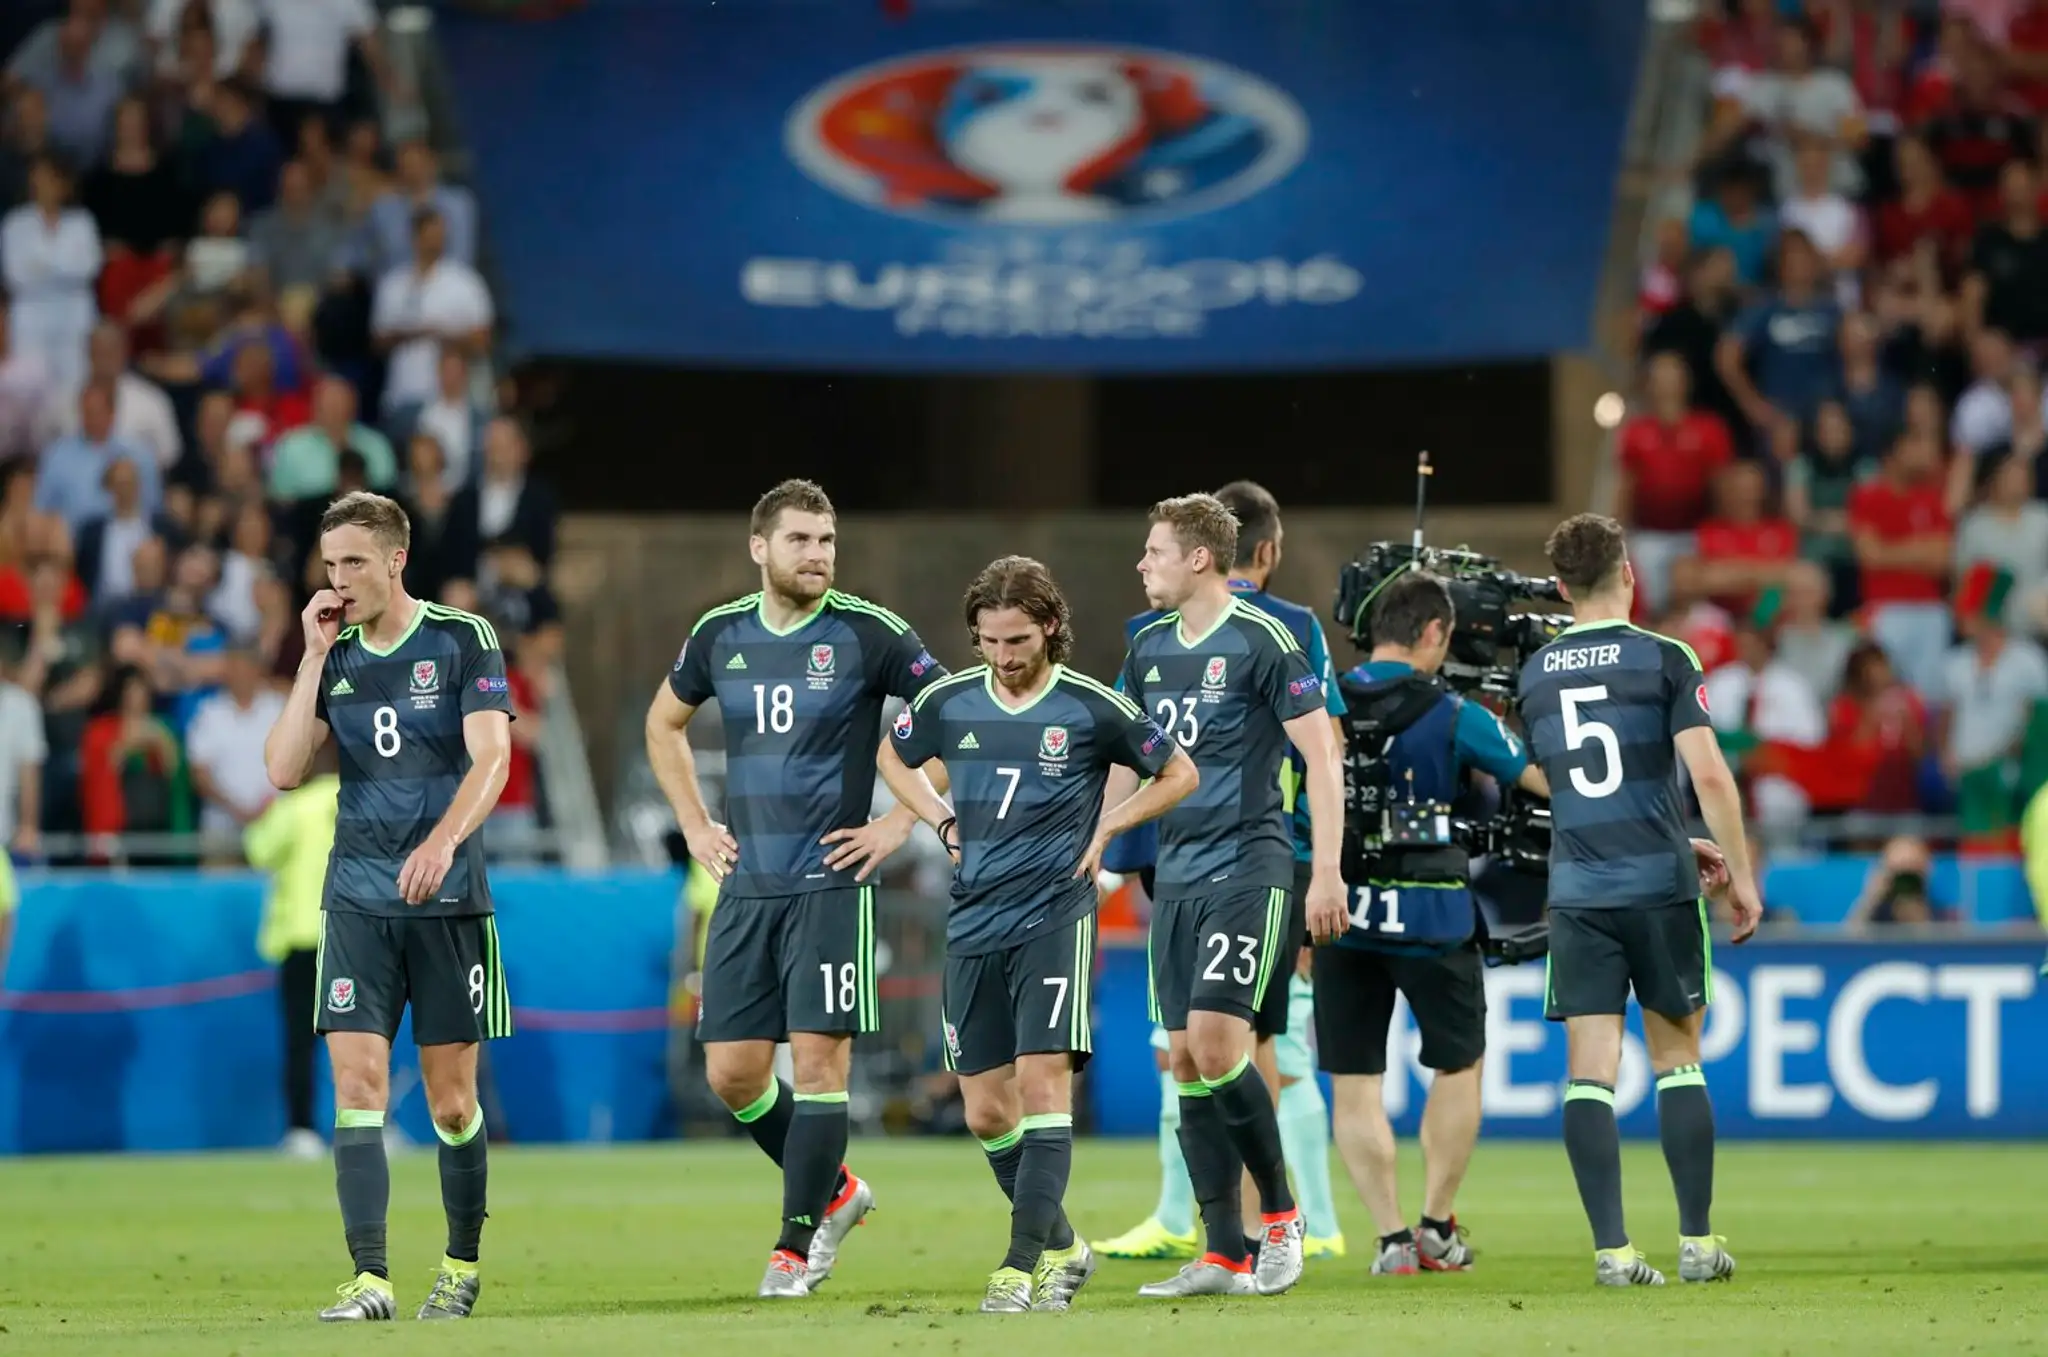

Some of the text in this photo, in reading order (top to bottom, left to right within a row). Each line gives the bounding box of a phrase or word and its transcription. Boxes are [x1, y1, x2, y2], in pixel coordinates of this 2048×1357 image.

[1543, 643, 1621, 673] CHESTER
[373, 706, 401, 758] 8
[753, 684, 795, 734] 18
[1156, 697, 1199, 748] 23
[1559, 684, 1624, 799] 5
[996, 767, 1021, 820] 7
[1202, 932, 1259, 985] 23
[468, 963, 485, 1015] 8
[819, 962, 857, 1014] 18
[1042, 977, 1068, 1029] 7
